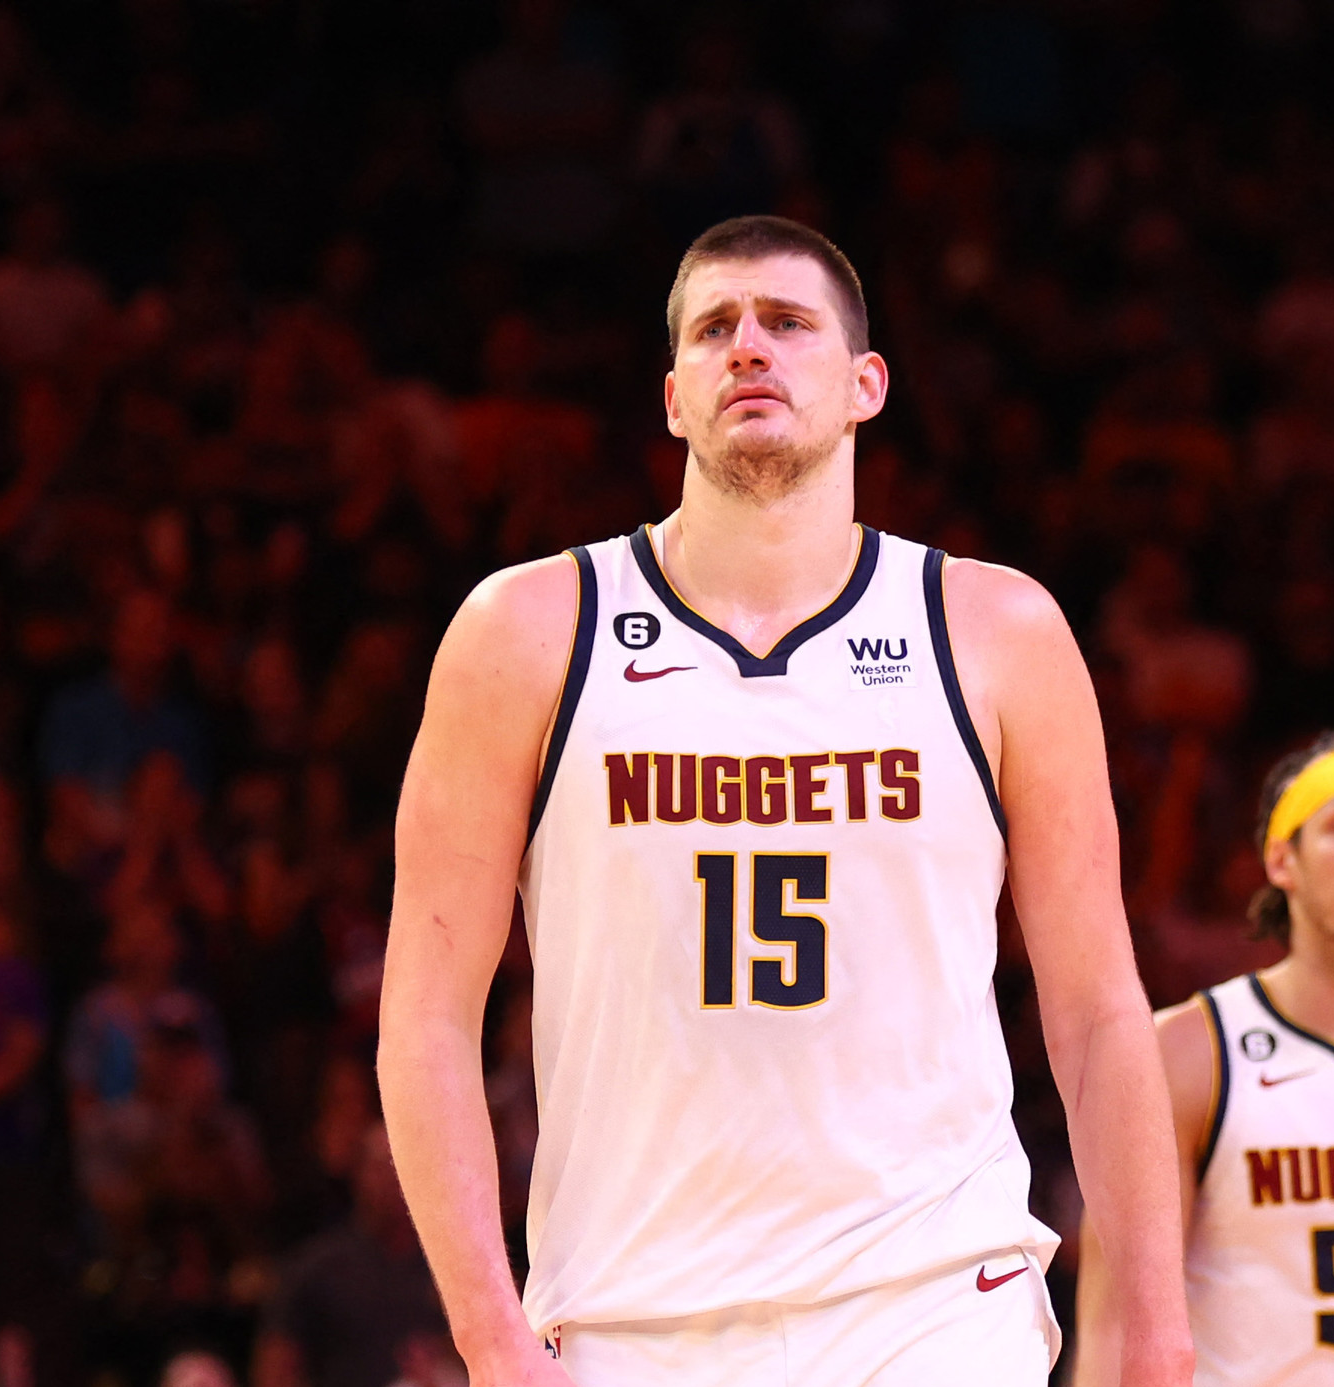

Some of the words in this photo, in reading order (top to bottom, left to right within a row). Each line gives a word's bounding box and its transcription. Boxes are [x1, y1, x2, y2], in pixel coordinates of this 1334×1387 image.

[623, 617, 649, 646] 6
[846, 637, 908, 661] WU
[850, 664, 911, 675] Western
[862, 674, 904, 686] Union
[603, 748, 922, 828] NUGGETS
[693, 851, 831, 1011] 15
